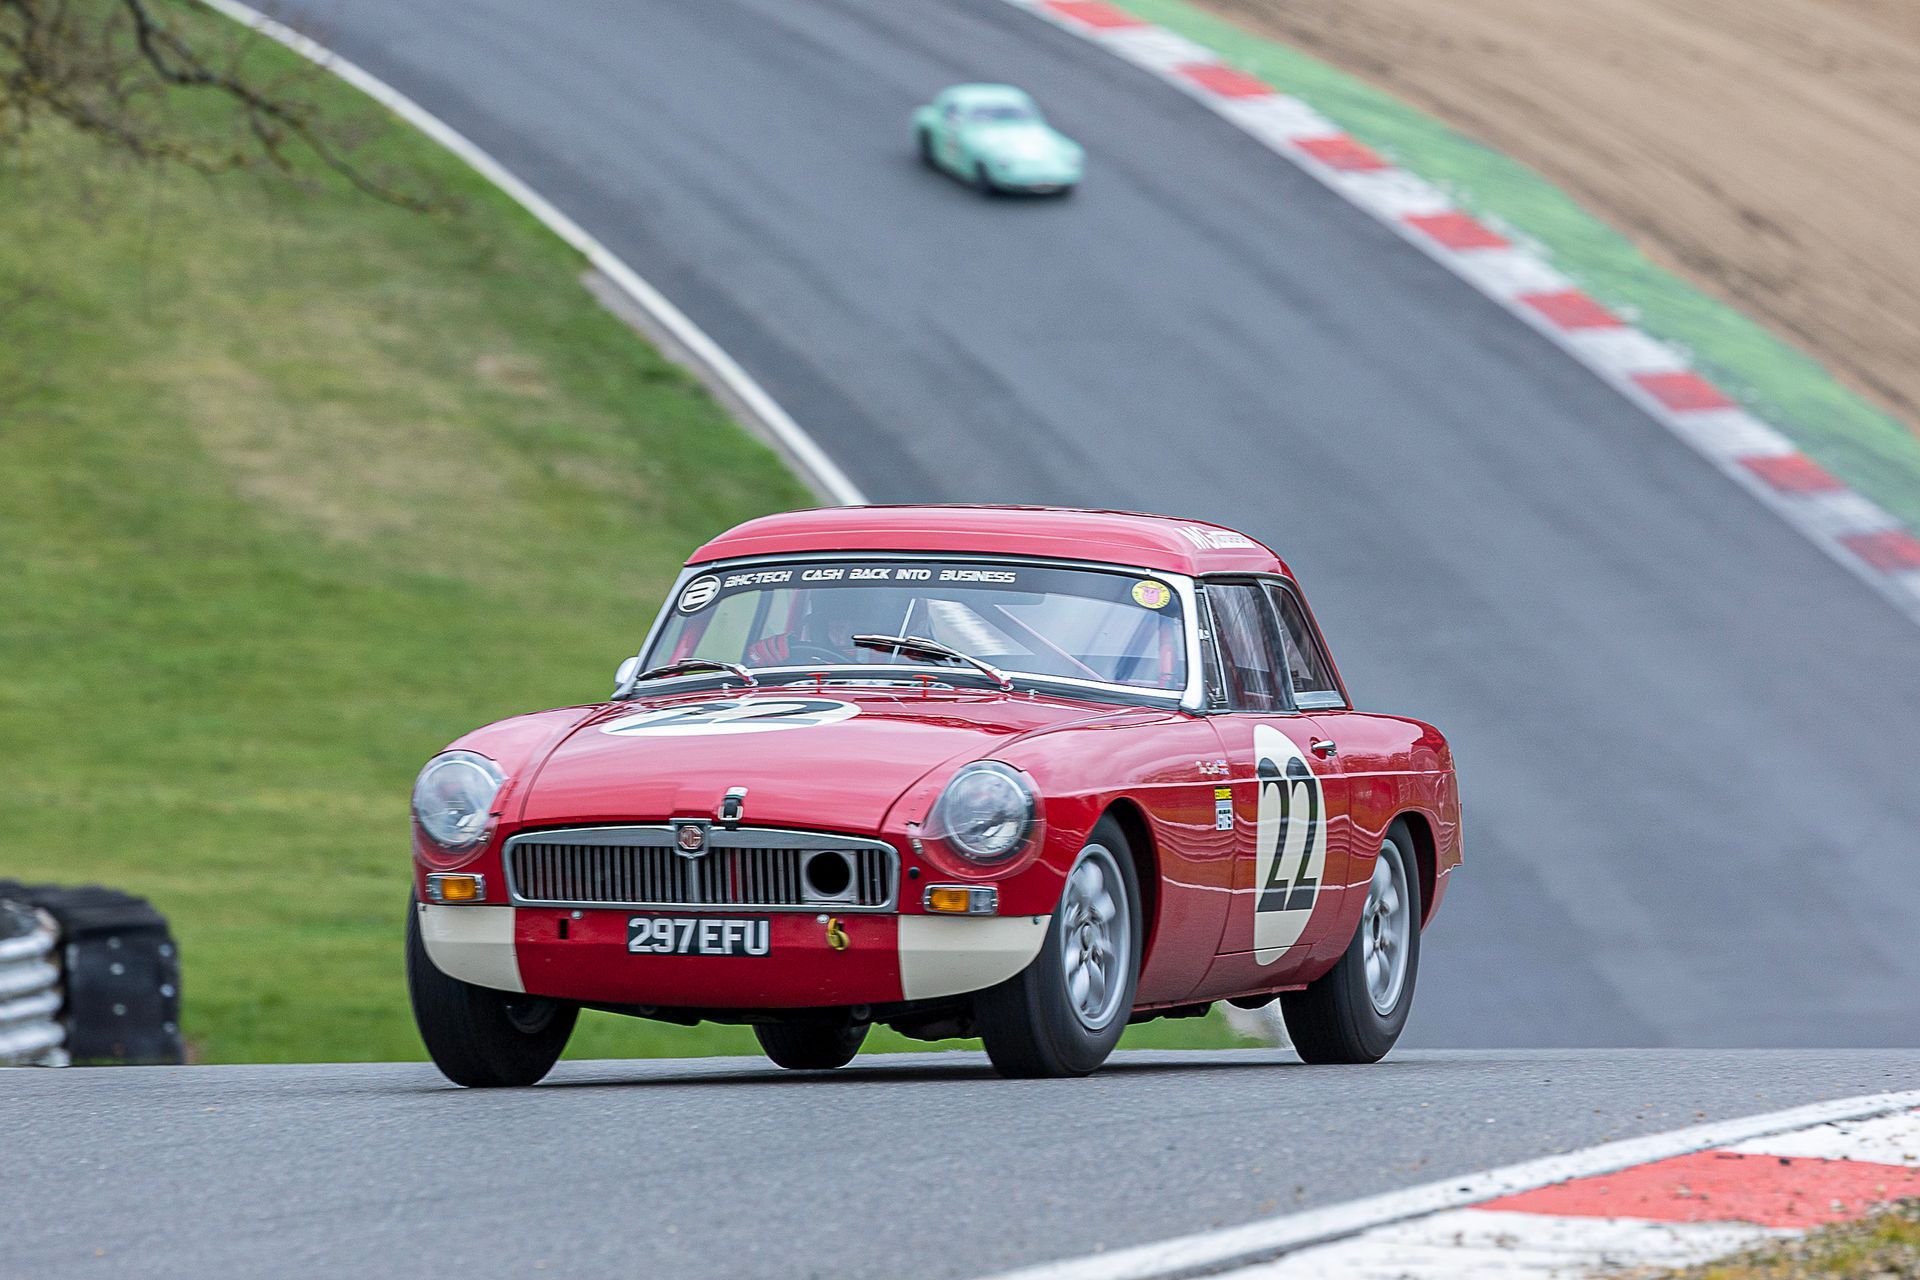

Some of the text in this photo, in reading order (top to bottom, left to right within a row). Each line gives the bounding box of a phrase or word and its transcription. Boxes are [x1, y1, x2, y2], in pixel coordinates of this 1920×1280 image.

[801, 568, 845, 581] CASH
[849, 568, 892, 580] BACK
[895, 568, 932, 580] INTO
[938, 569, 1017, 584] BUSINESS
[609, 701, 845, 732] 22
[679, 827, 703, 848] MG
[1256, 756, 1319, 913] 22
[628, 917, 770, 956] 297EFU
